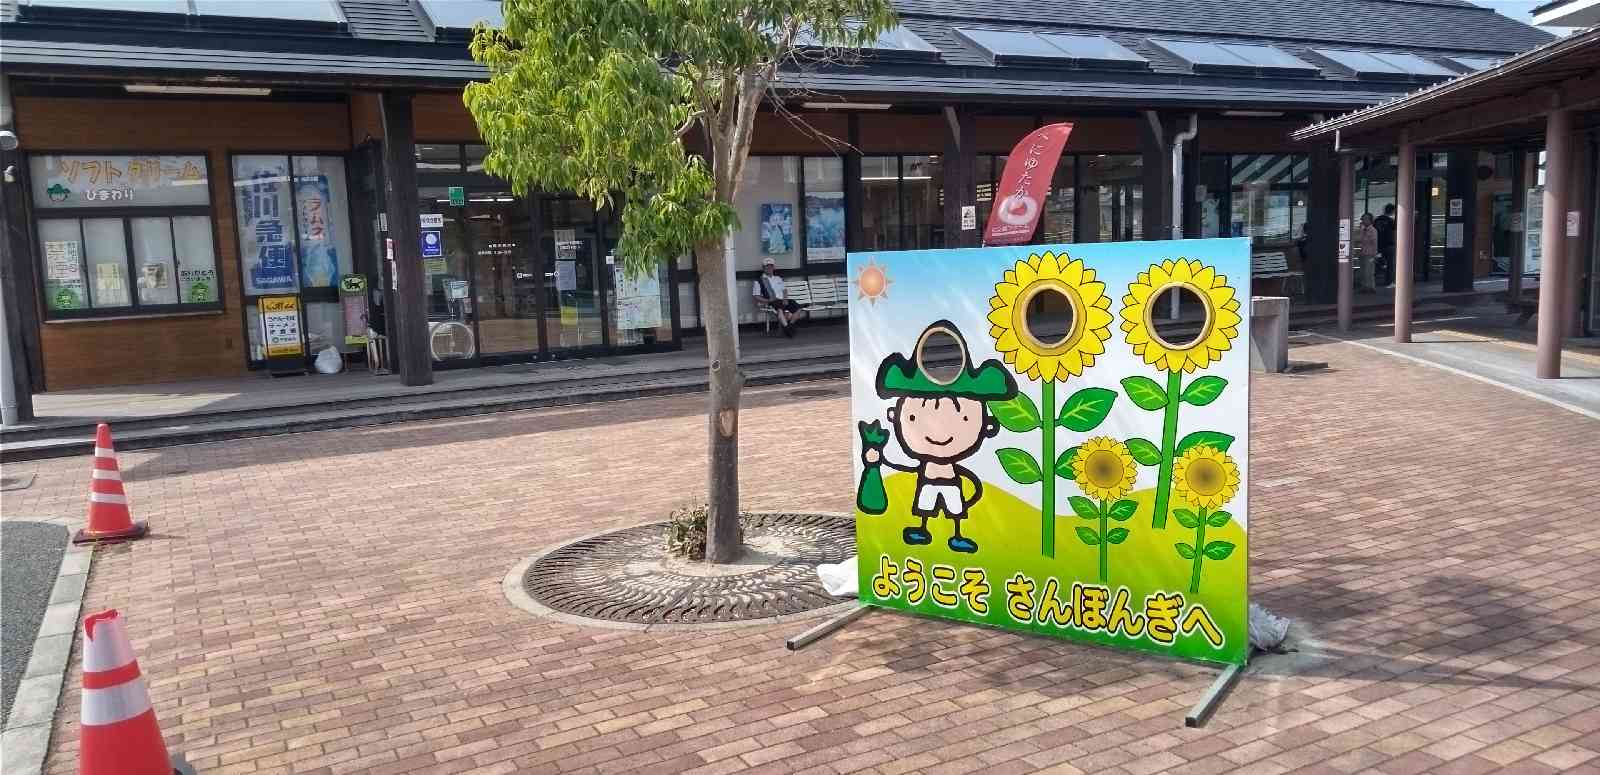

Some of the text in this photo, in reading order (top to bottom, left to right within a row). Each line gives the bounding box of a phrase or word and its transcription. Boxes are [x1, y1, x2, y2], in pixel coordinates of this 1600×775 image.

[86, 188, 134, 201] ひまわり
[241, 170, 287, 268] 佐川急便
[310, 198, 326, 240] ラムネ
[255, 275, 294, 284] SAGAWA
[872, 555, 1225, 649] ようこそ さんぼんぎへ
